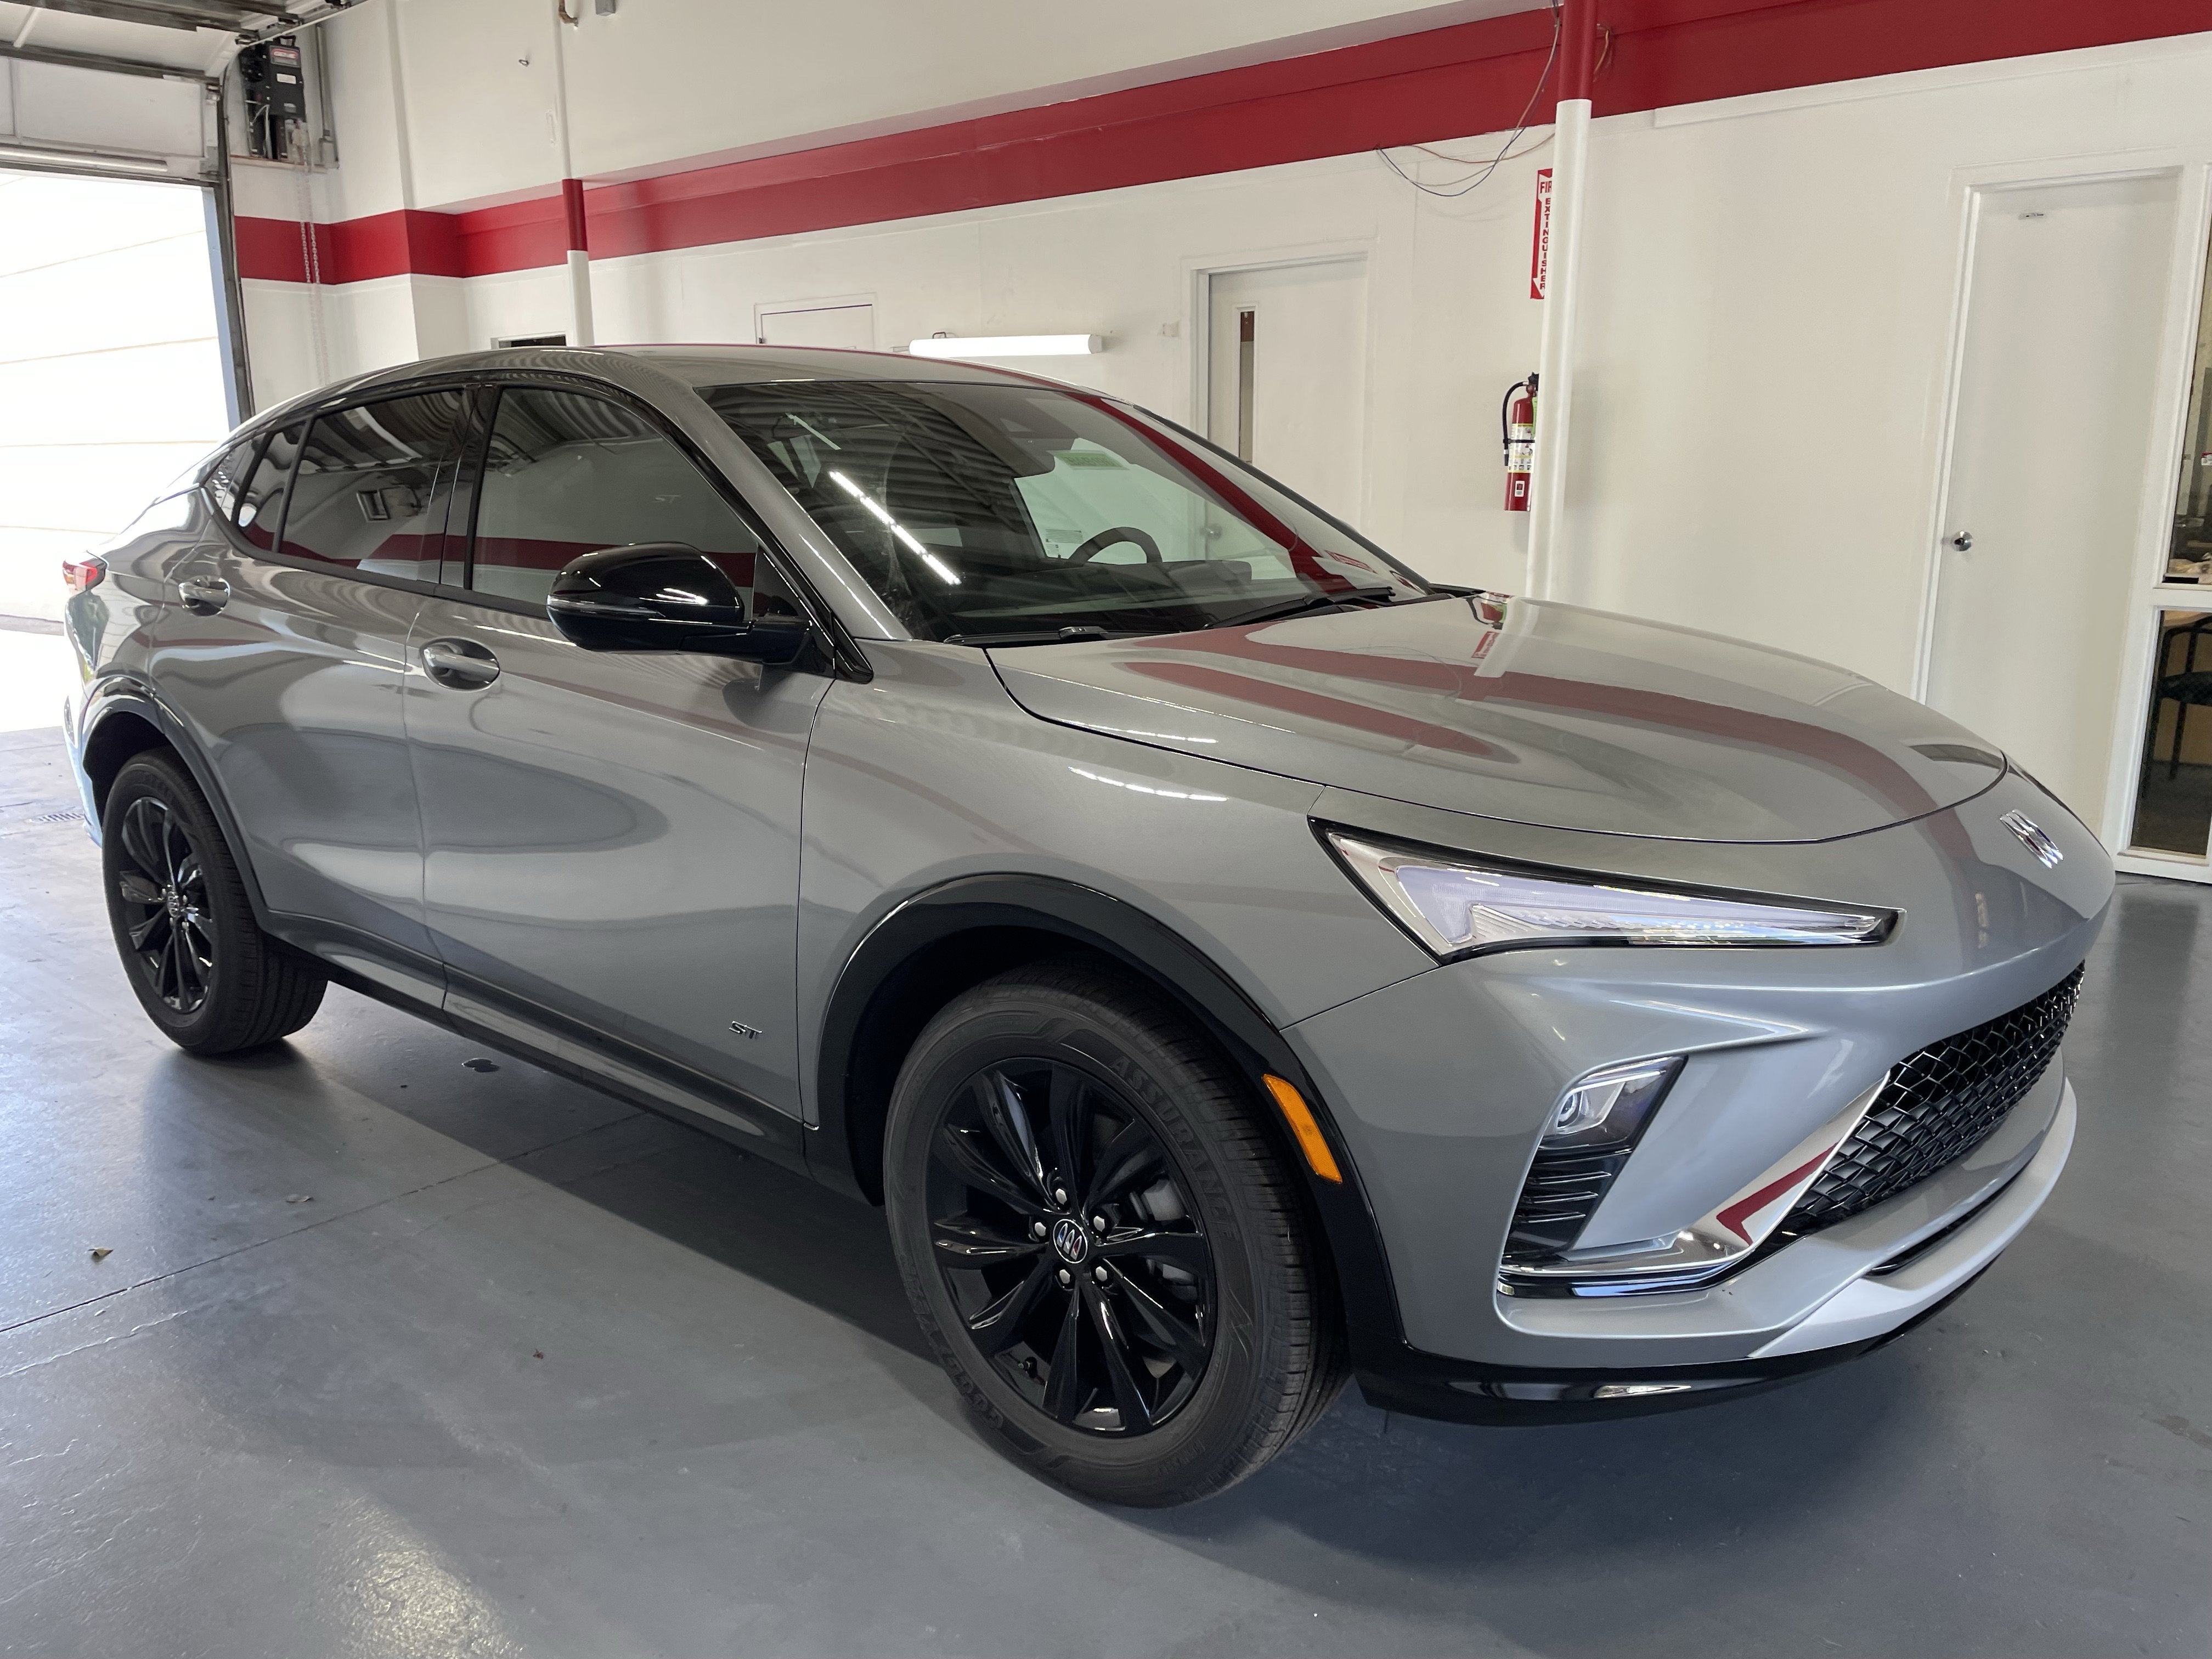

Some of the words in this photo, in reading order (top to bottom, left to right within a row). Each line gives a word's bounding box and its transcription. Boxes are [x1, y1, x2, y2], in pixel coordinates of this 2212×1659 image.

[1540, 180, 1552, 193] FIR
[729, 1020, 763, 1039] ST
[1109, 1055, 1238, 1241] ASSURANCE
